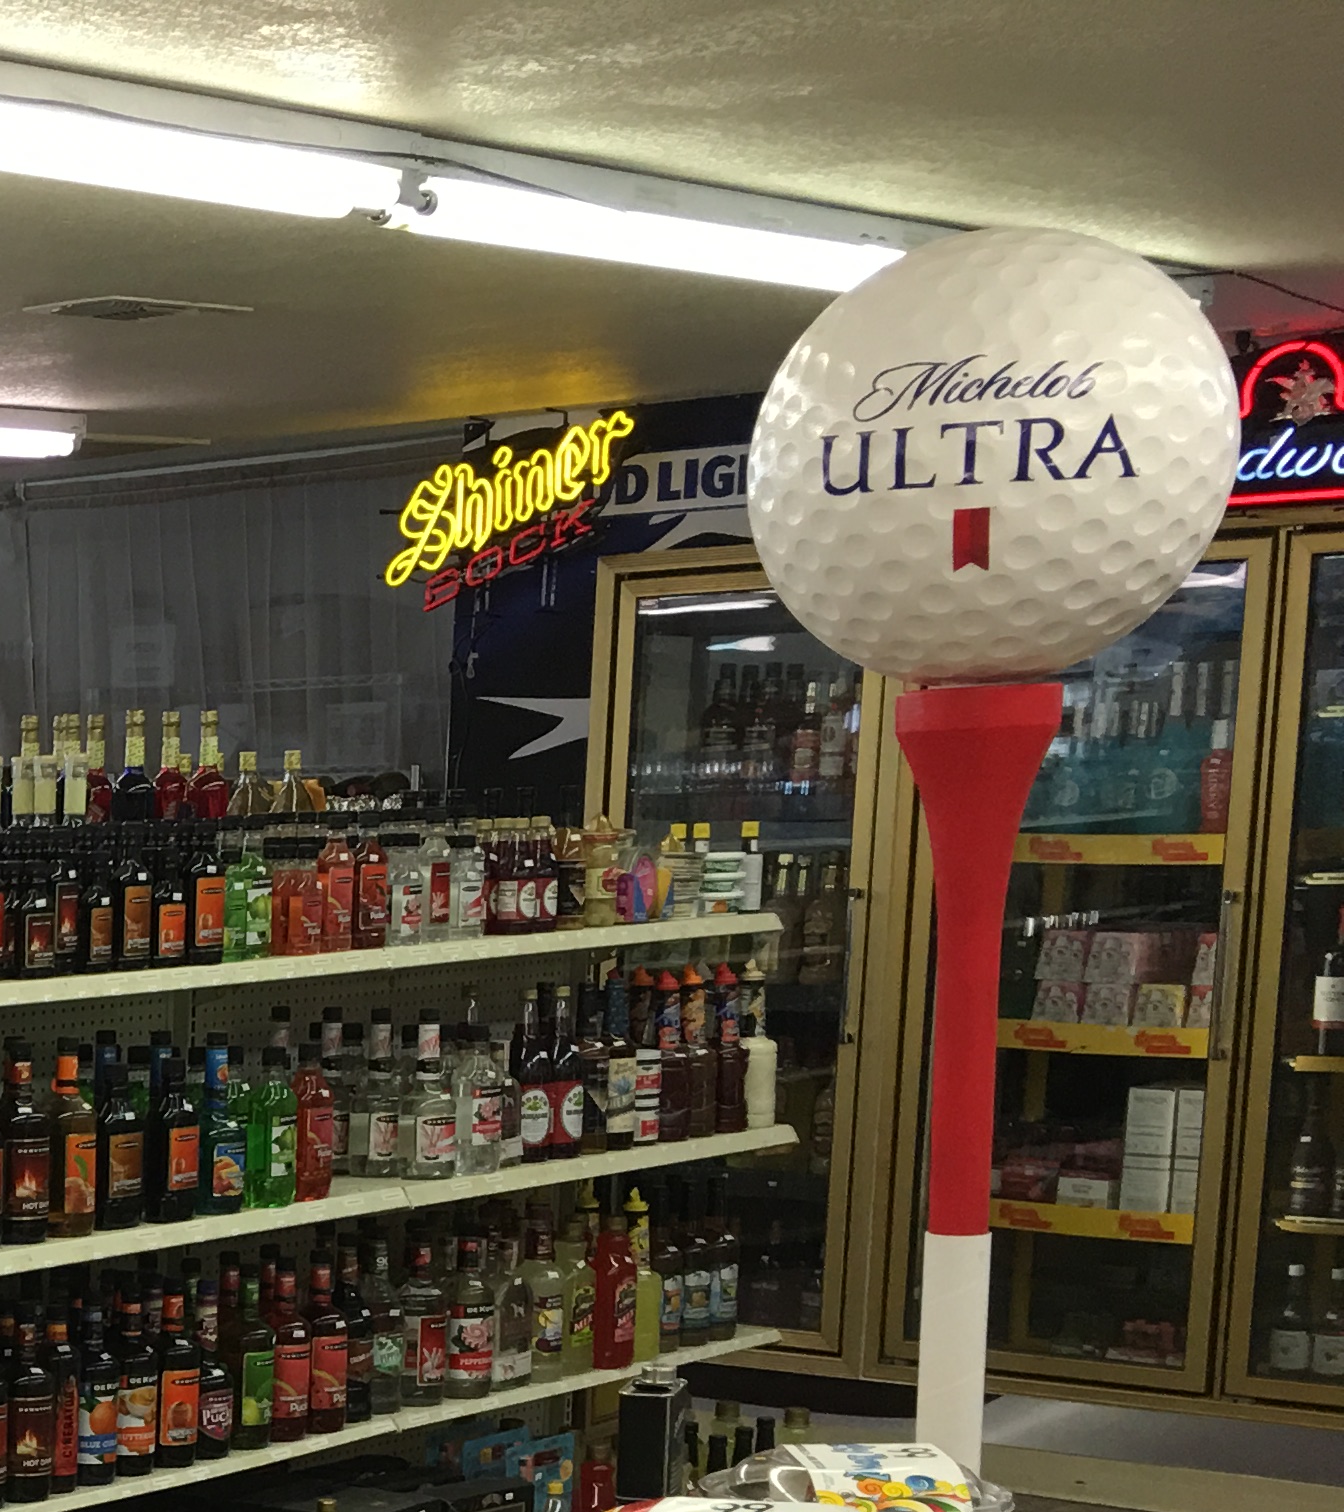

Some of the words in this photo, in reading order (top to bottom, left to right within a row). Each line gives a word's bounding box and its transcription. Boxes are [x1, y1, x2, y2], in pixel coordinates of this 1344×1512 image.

[852, 353, 1104, 423] Michelob
[656, 455, 750, 502] LIG
[821, 413, 1140, 497] ULTRA
[385, 409, 635, 588] Shiner
[423, 499, 596, 613] BOCK
